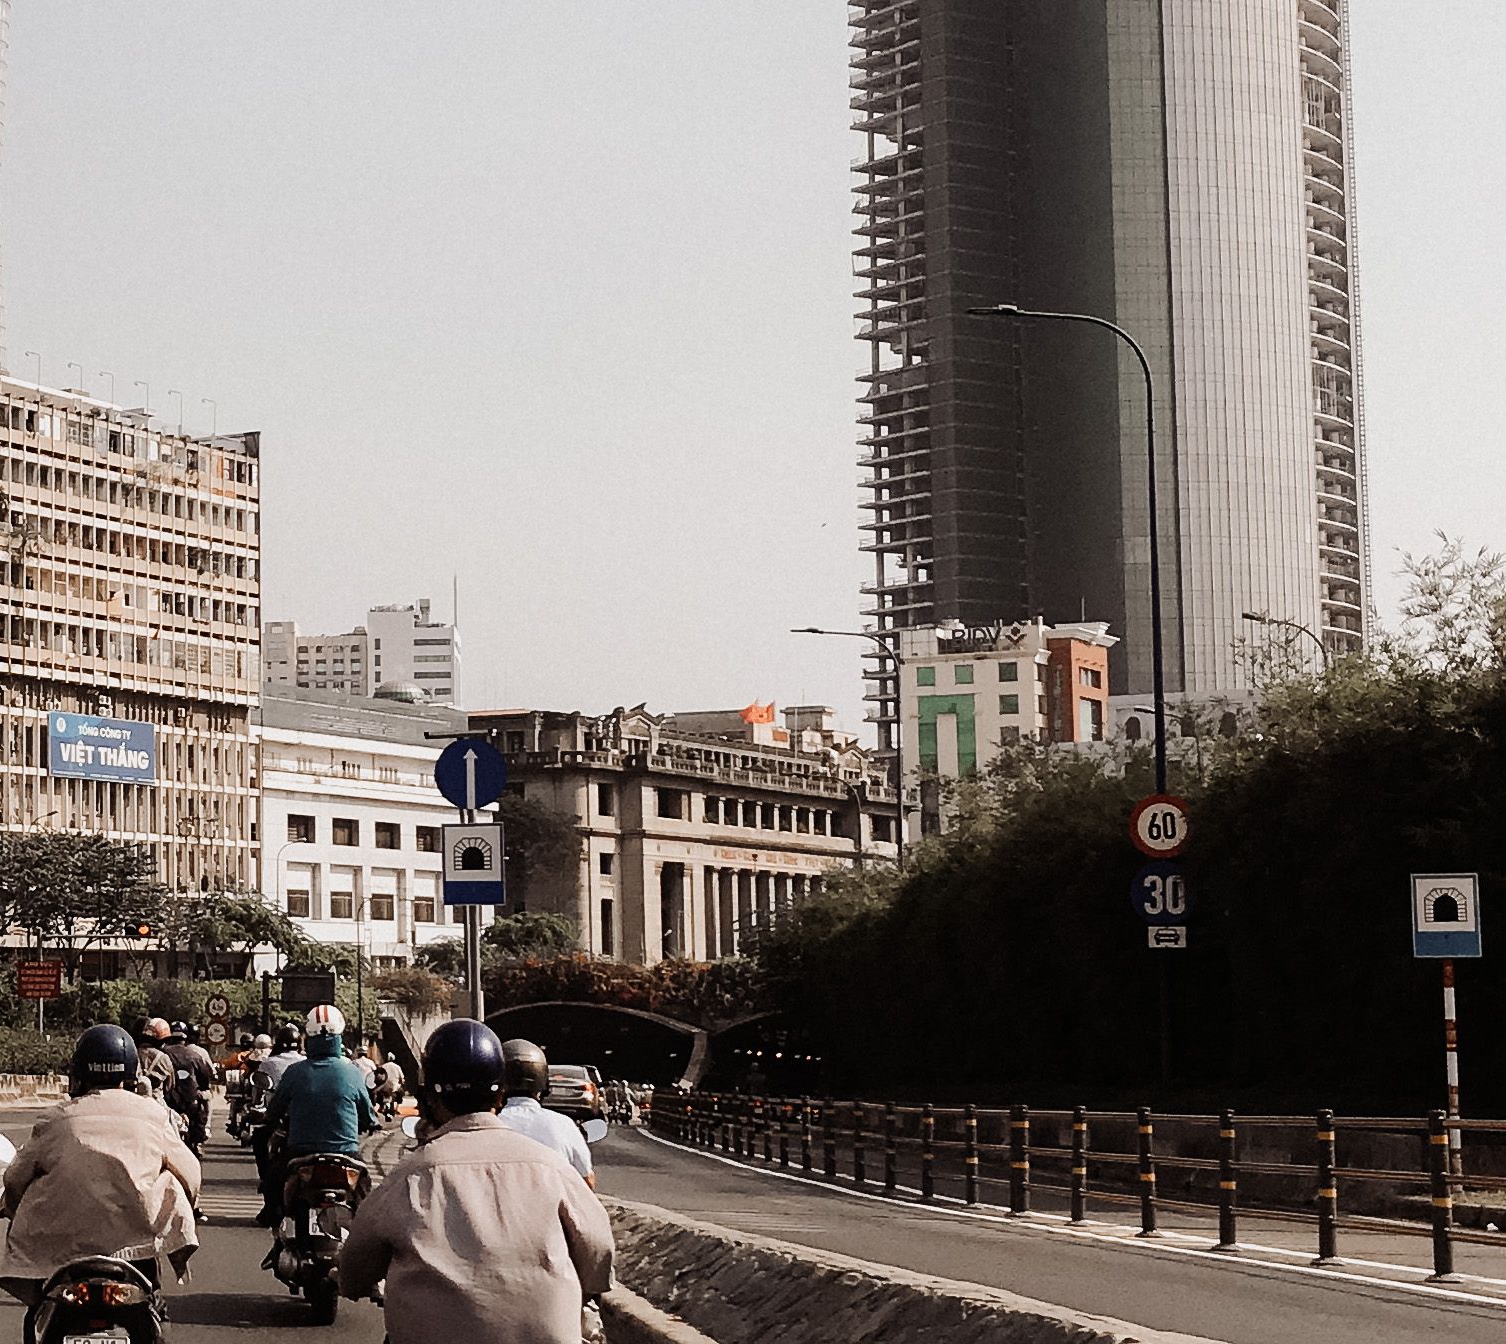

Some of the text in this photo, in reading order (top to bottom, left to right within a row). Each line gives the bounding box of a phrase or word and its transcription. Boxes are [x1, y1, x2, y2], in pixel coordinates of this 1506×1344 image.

[100, 726, 121, 739] CÔNG
[121, 730, 132, 740] TY
[60, 740, 150, 770] VIỆT THẮNG
[1148, 811, 1176, 840] 60
[1144, 875, 1185, 915] 30
